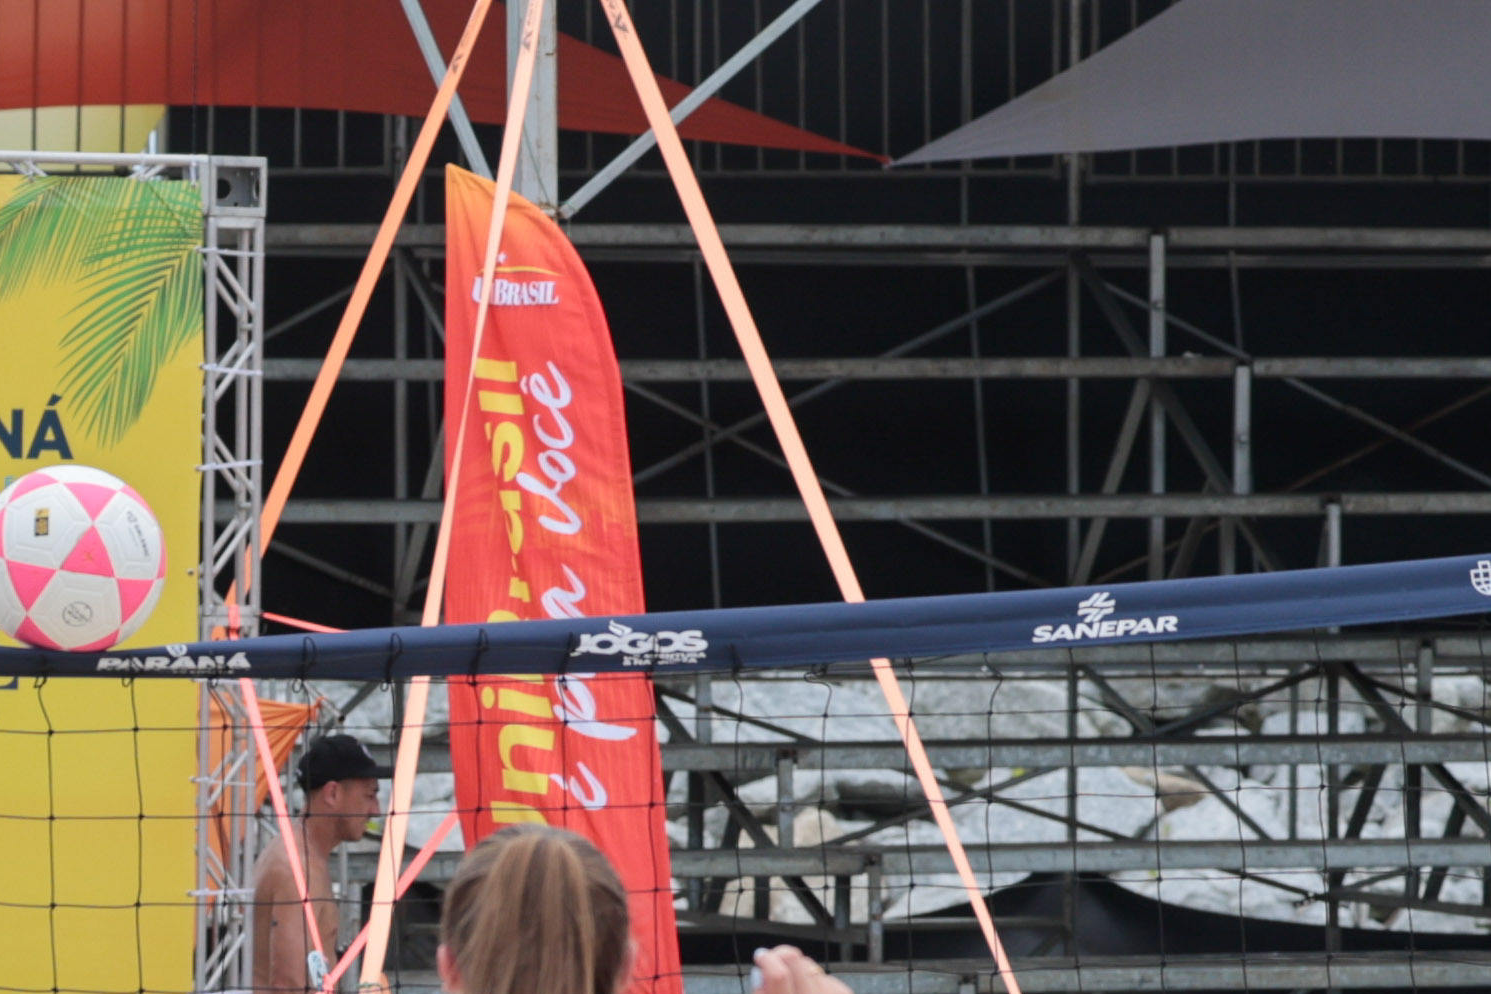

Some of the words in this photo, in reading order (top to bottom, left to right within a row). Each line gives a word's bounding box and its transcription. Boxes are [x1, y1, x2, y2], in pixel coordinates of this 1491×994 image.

[471, 276, 560, 306] UBRASIL
[1032, 615, 1178, 643] SANEPAR
[96, 652, 251, 671] PARANÁ
